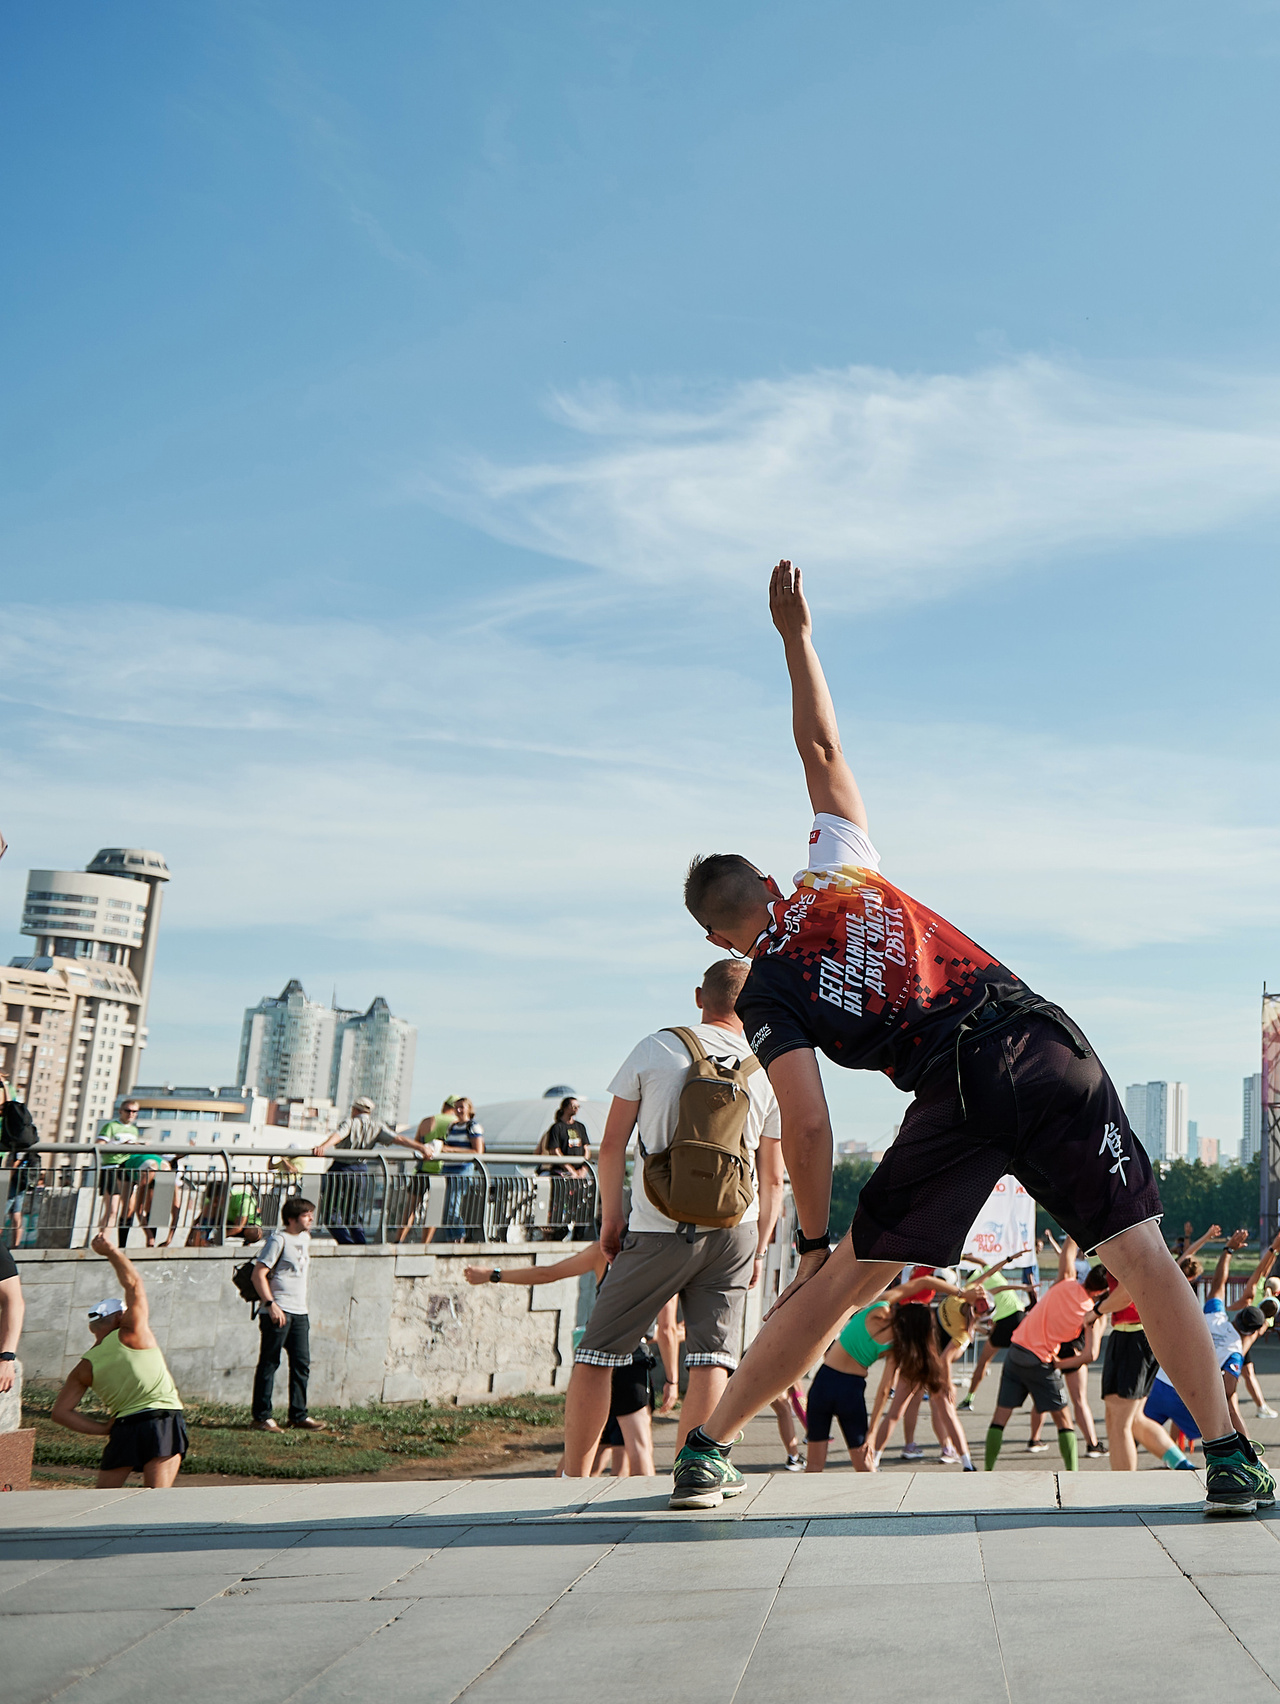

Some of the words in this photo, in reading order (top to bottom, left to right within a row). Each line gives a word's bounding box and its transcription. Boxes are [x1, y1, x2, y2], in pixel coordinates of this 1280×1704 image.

[844, 912, 868, 989] ГРАНИЦЕ
[885, 906, 907, 967] СВЕТА
[819, 955, 845, 1008] БЕГИ
[864, 945, 886, 998] ДВУХ
[844, 990, 863, 1017] НА
